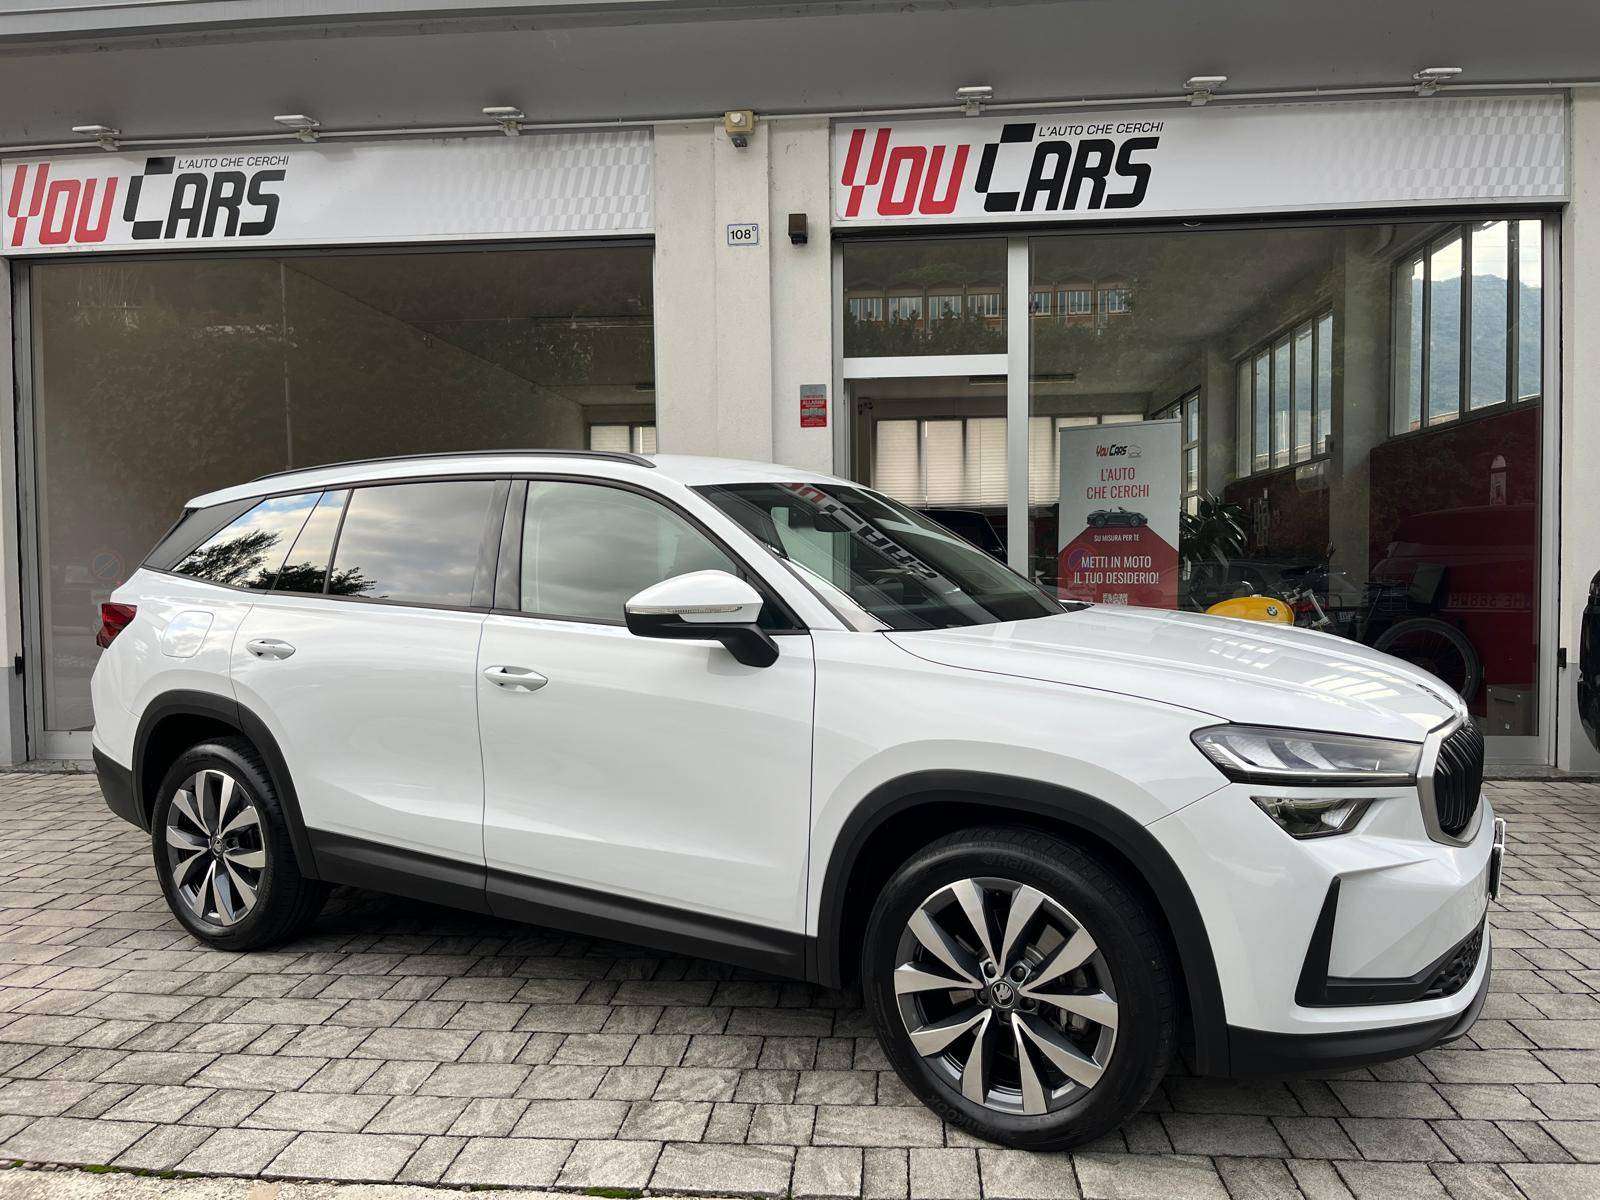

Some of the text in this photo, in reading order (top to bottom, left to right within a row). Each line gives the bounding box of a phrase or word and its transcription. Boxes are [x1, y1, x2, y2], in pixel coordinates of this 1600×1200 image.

[1039, 122, 1164, 137] L'AUTO CHE CERCHI
[178, 156, 289, 169] L'AUTO CHE CERCHI
[1100, 467, 1136, 482] L'AUTO
[1086, 484, 1150, 500] CHE CERCHI
[1102, 534, 1122, 542] MISURA
[1123, 534, 1132, 542] PER
[1082, 556, 1152, 569] METTI IN MOTO
[1074, 571, 1160, 584] IL TUO DESIDERIO!
